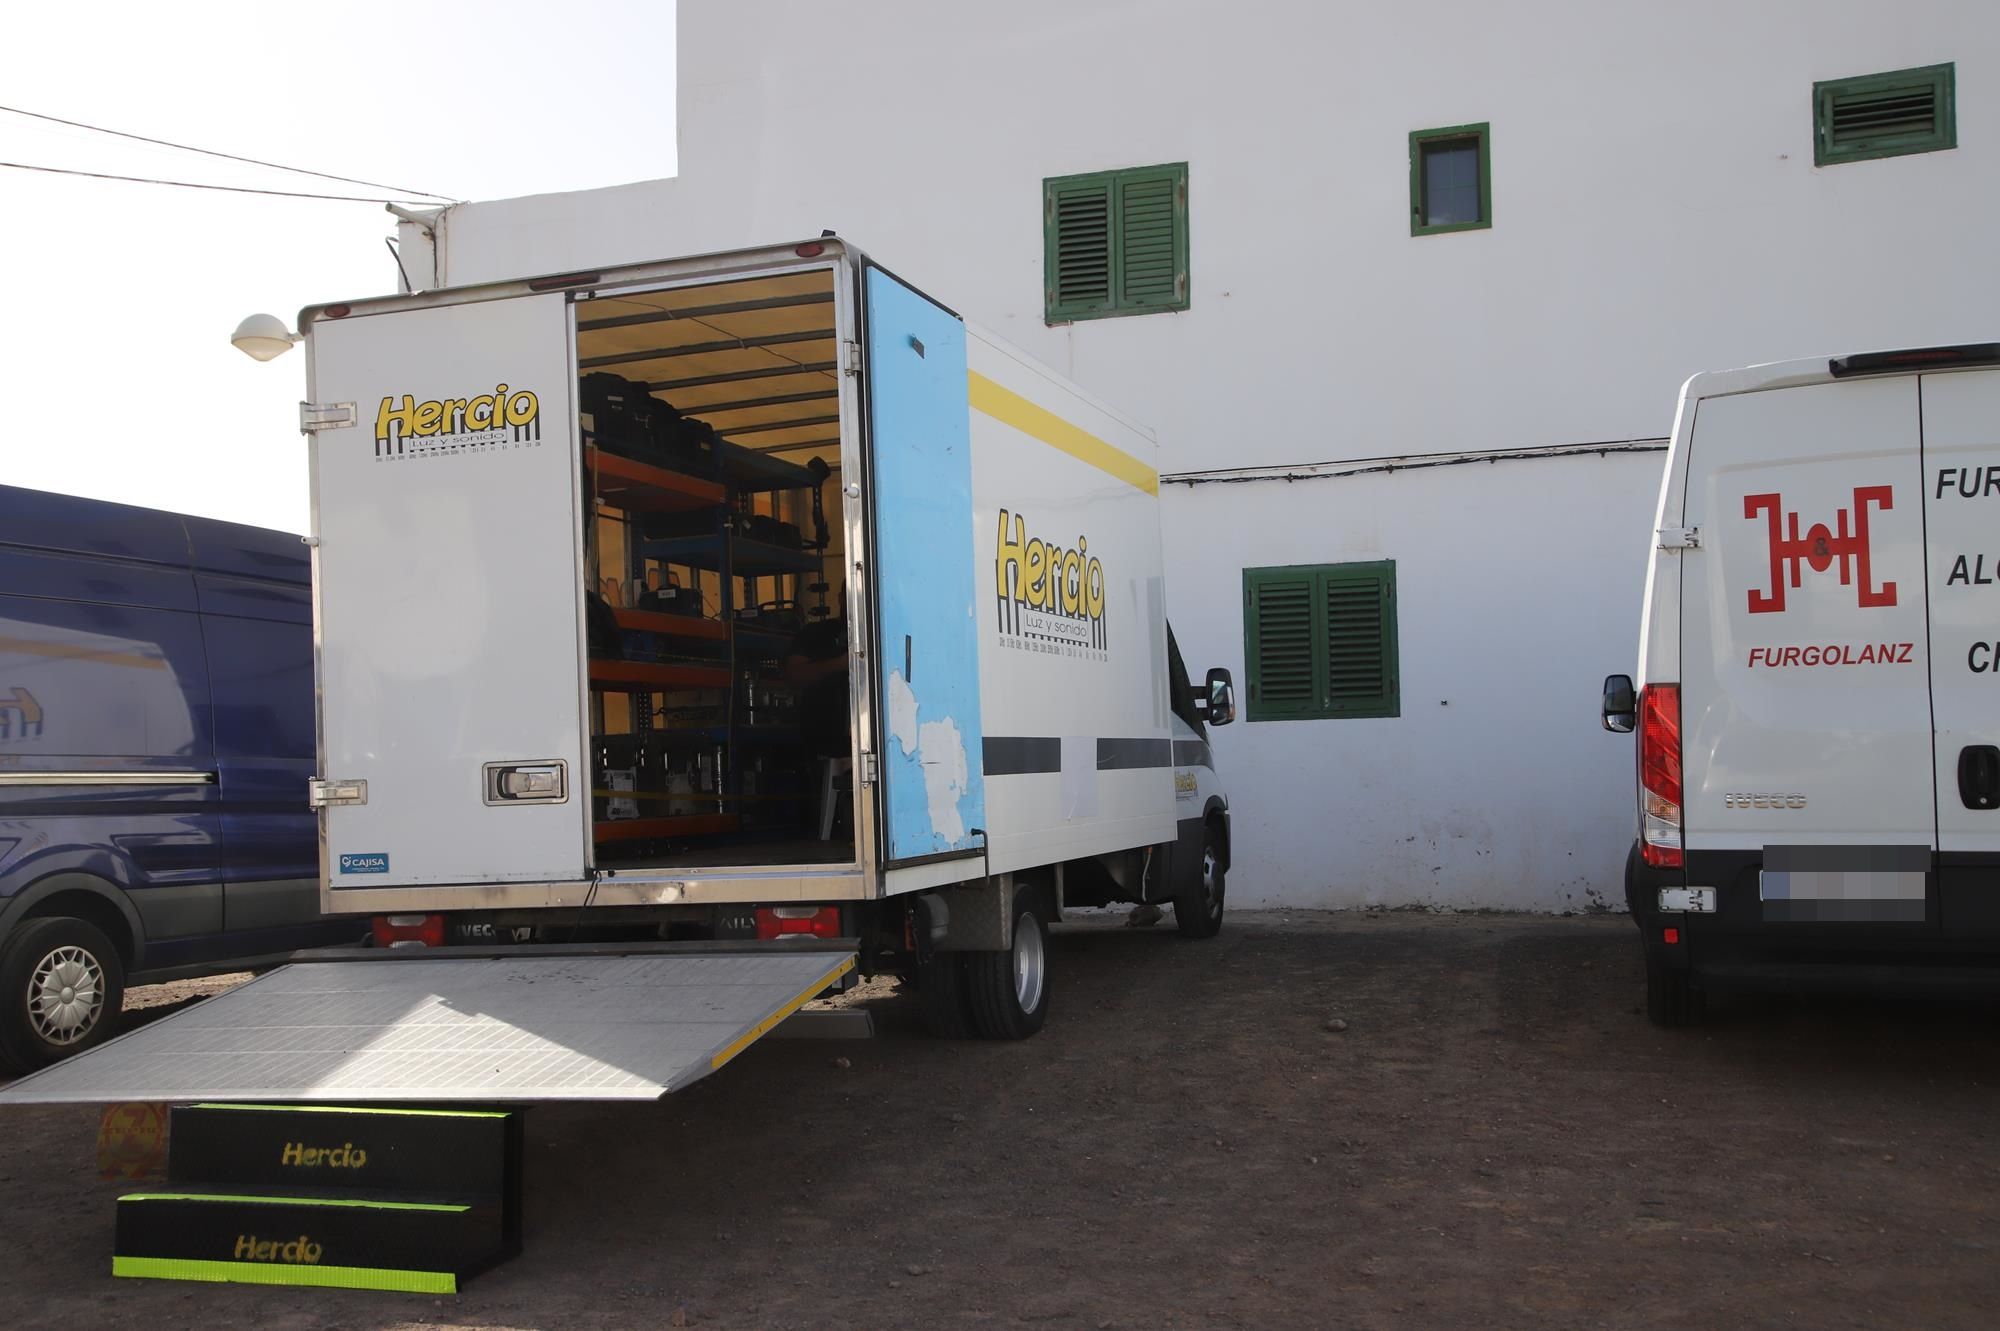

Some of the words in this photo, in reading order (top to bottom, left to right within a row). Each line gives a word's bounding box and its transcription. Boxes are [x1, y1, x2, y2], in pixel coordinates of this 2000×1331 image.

[376, 383, 539, 440] Hercio
[412, 437, 435, 447] Luz
[453, 432, 505, 443] sonido
[997, 508, 1105, 621] Hercio
[1946, 554, 2000, 585] AL
[1026, 613, 1044, 629] Luz
[1045, 620, 1052, 633] y
[1055, 621, 1087, 637] sonido
[1747, 643, 1914, 667] FURGOLANZ
[1725, 793, 1807, 809] IVECO
[352, 858, 385, 867] CAJISA
[282, 1142, 367, 1168] Hercio
